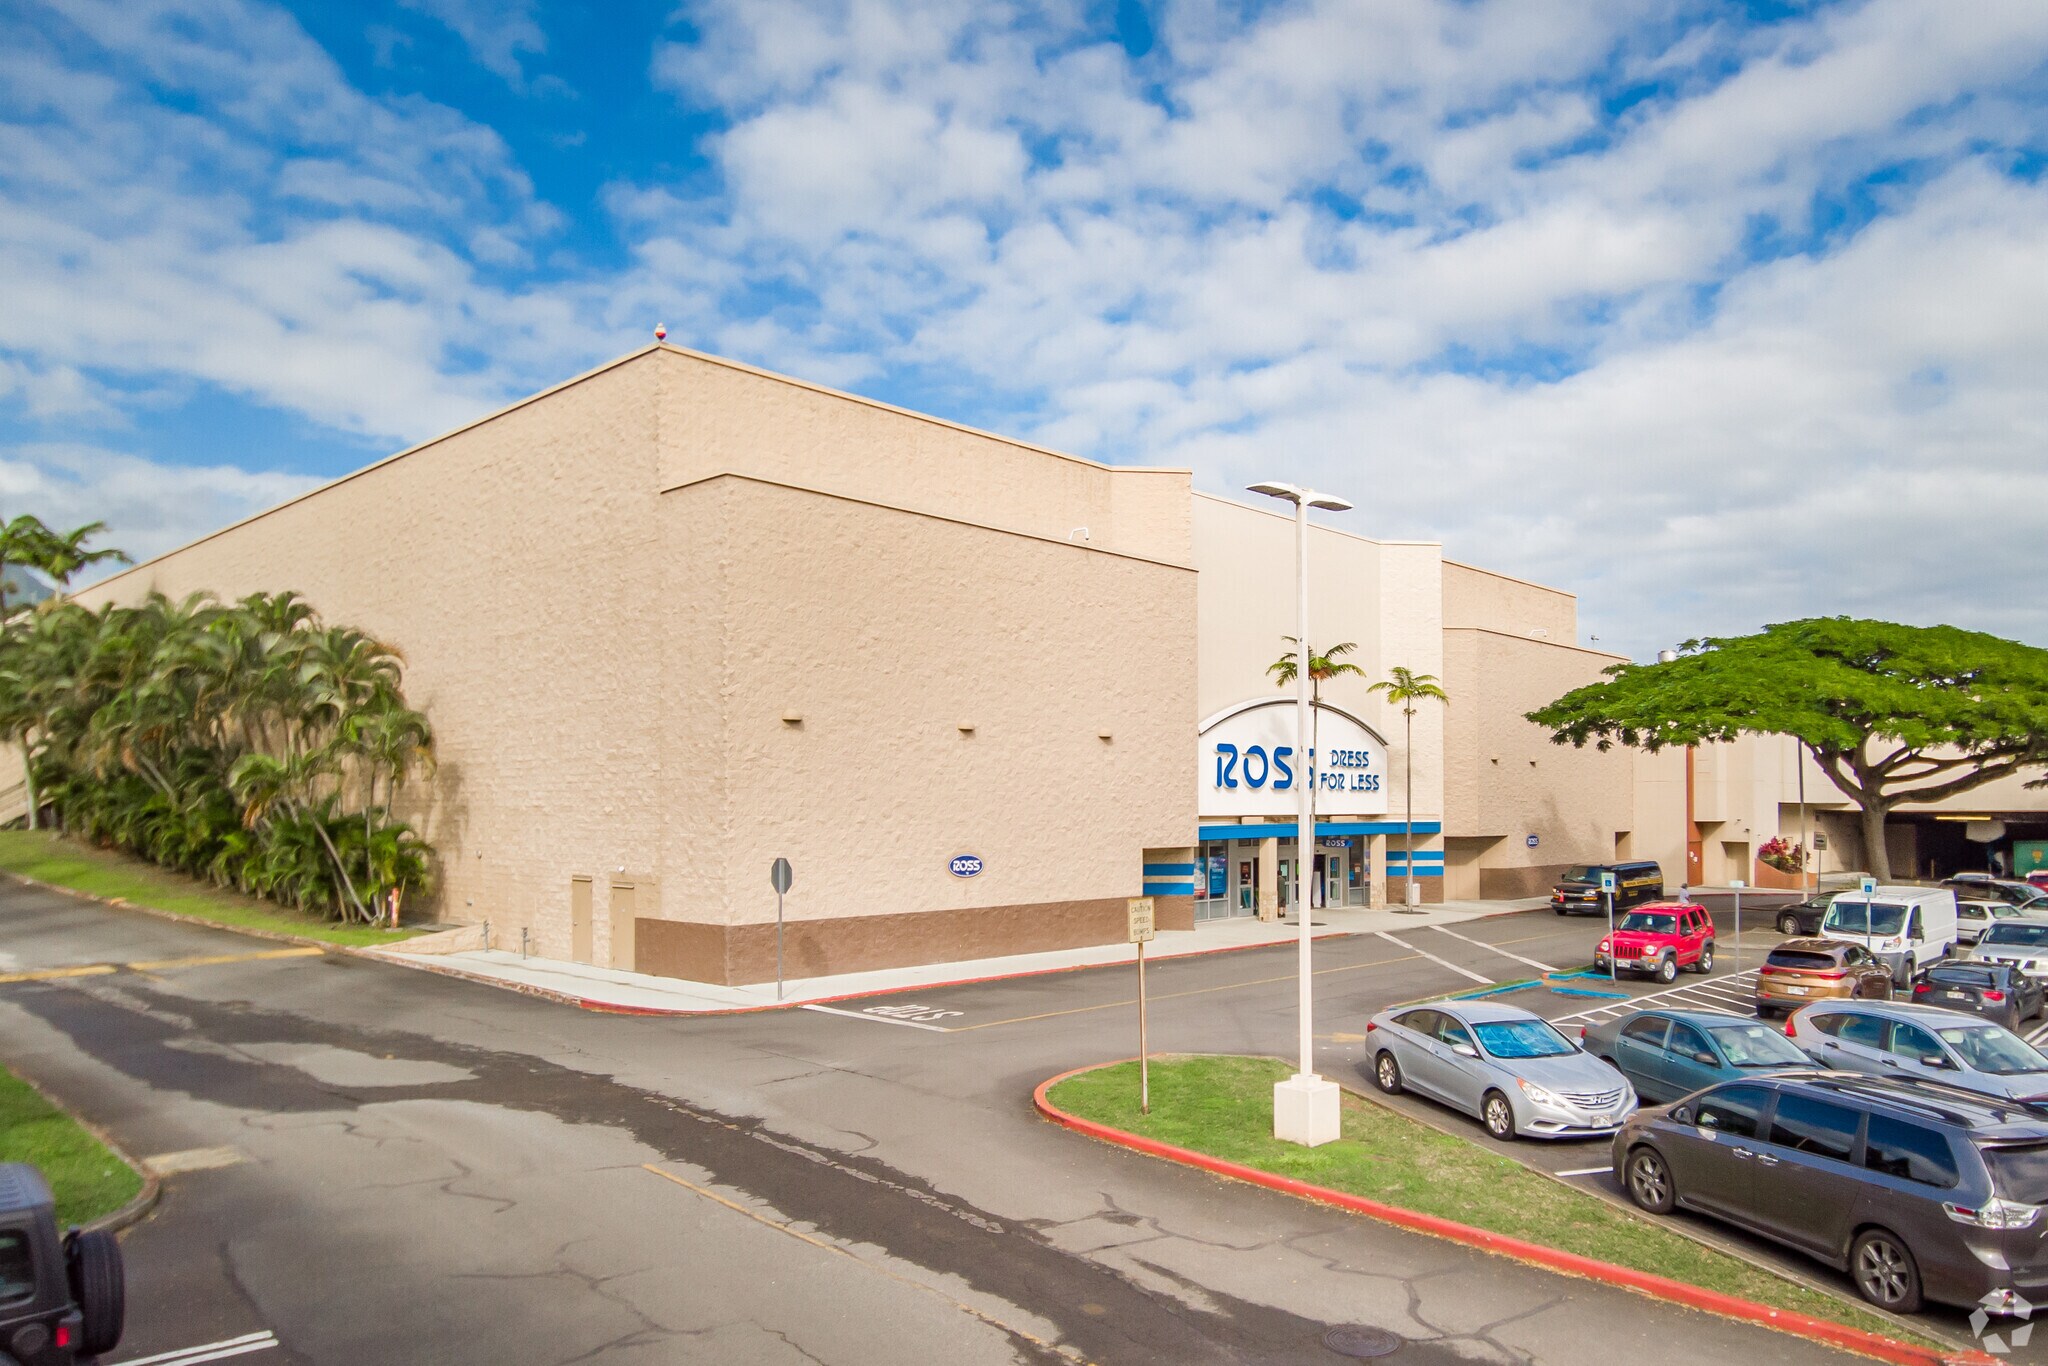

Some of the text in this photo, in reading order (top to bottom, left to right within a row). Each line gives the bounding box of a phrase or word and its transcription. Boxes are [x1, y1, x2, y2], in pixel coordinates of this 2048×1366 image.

[1331, 749, 1369, 767] DRESS
[1320, 773, 1379, 791] FOR LESS
[1325, 839, 1346, 847] ROSS
[952, 860, 981, 872] ROSS
[1131, 905, 1151, 914] CAUTION
[1133, 916, 1150, 925] SPEED
